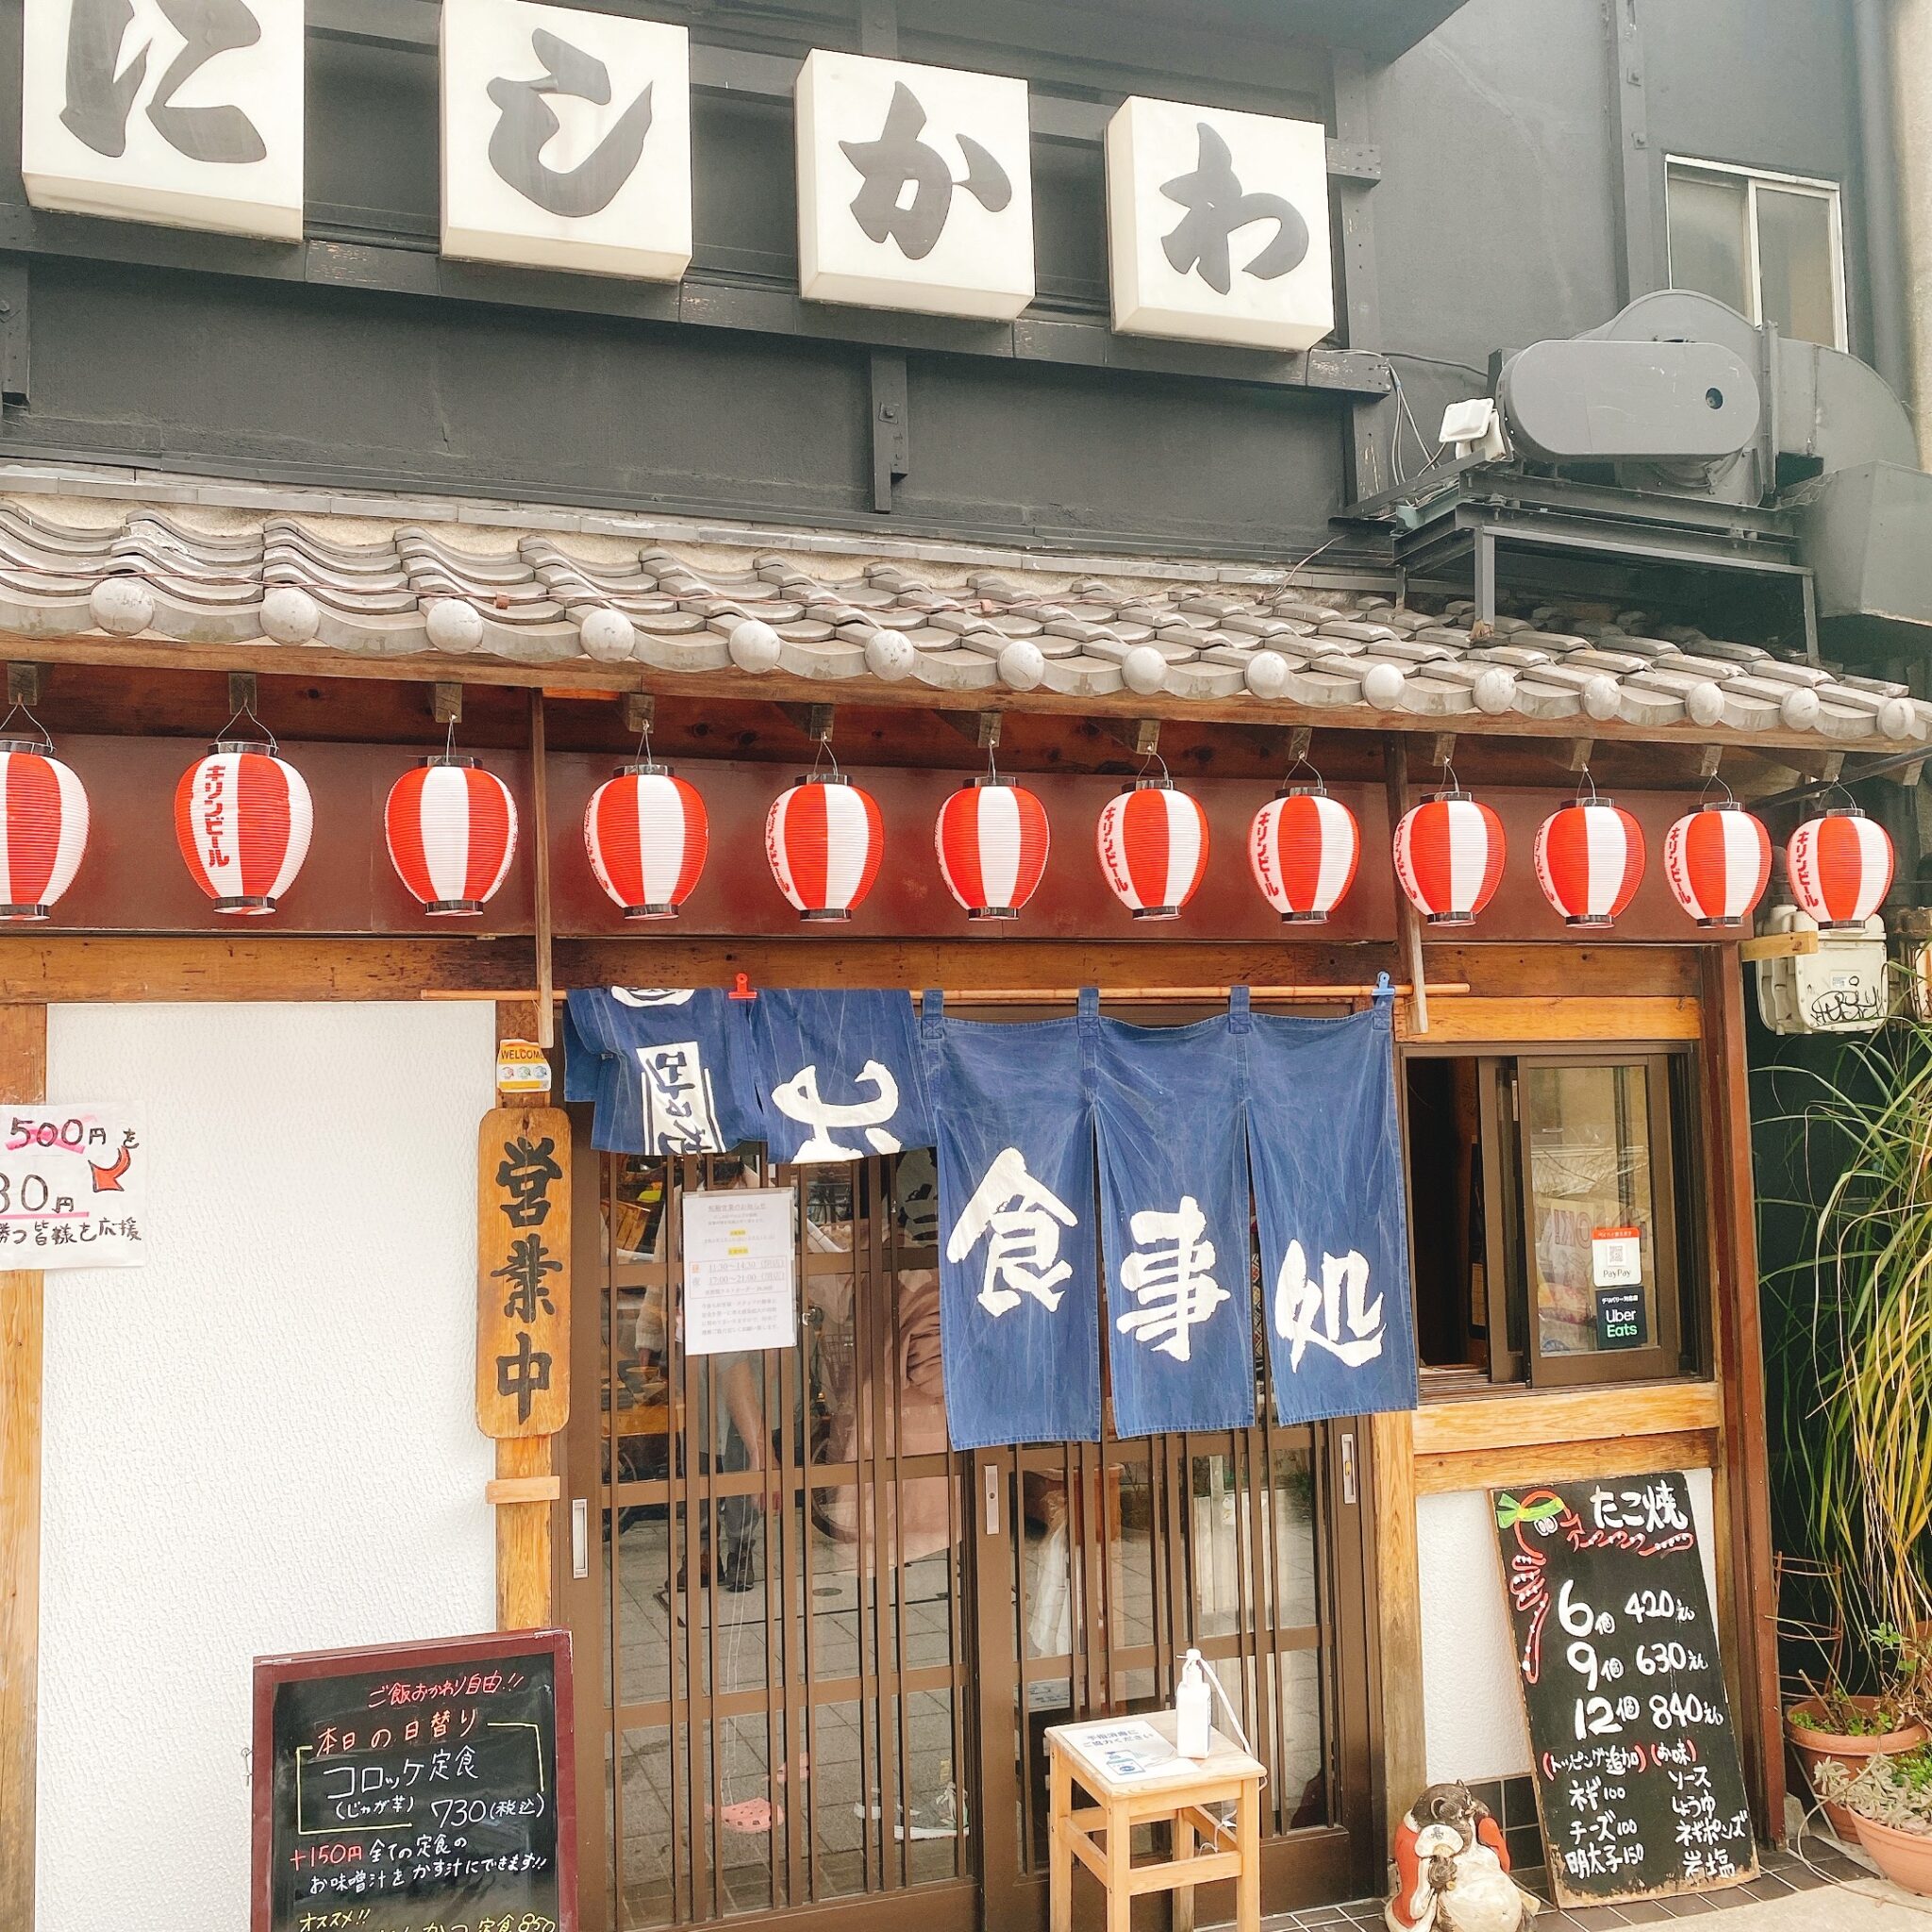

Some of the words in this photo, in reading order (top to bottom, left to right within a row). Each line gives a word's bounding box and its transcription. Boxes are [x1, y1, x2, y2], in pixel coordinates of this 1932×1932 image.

[204, 765, 229, 868] キリンビール
[1796, 831, 1820, 908] キリンビール
[491, 1137, 563, 1425] 営業中
[1603, 1268, 1631, 1278] PayPay
[1606, 1308, 1636, 1324] Uber
[1607, 1324, 1638, 1338] Eats
[1590, 1478, 1689, 1533] たこ焼
[324, 1745, 478, 1799] コロッケ定食
[1668, 1766, 1712, 1790] ソース
[1672, 1790, 1716, 1820] しょうゆ
[1682, 1848, 1736, 1878] 岩塩
